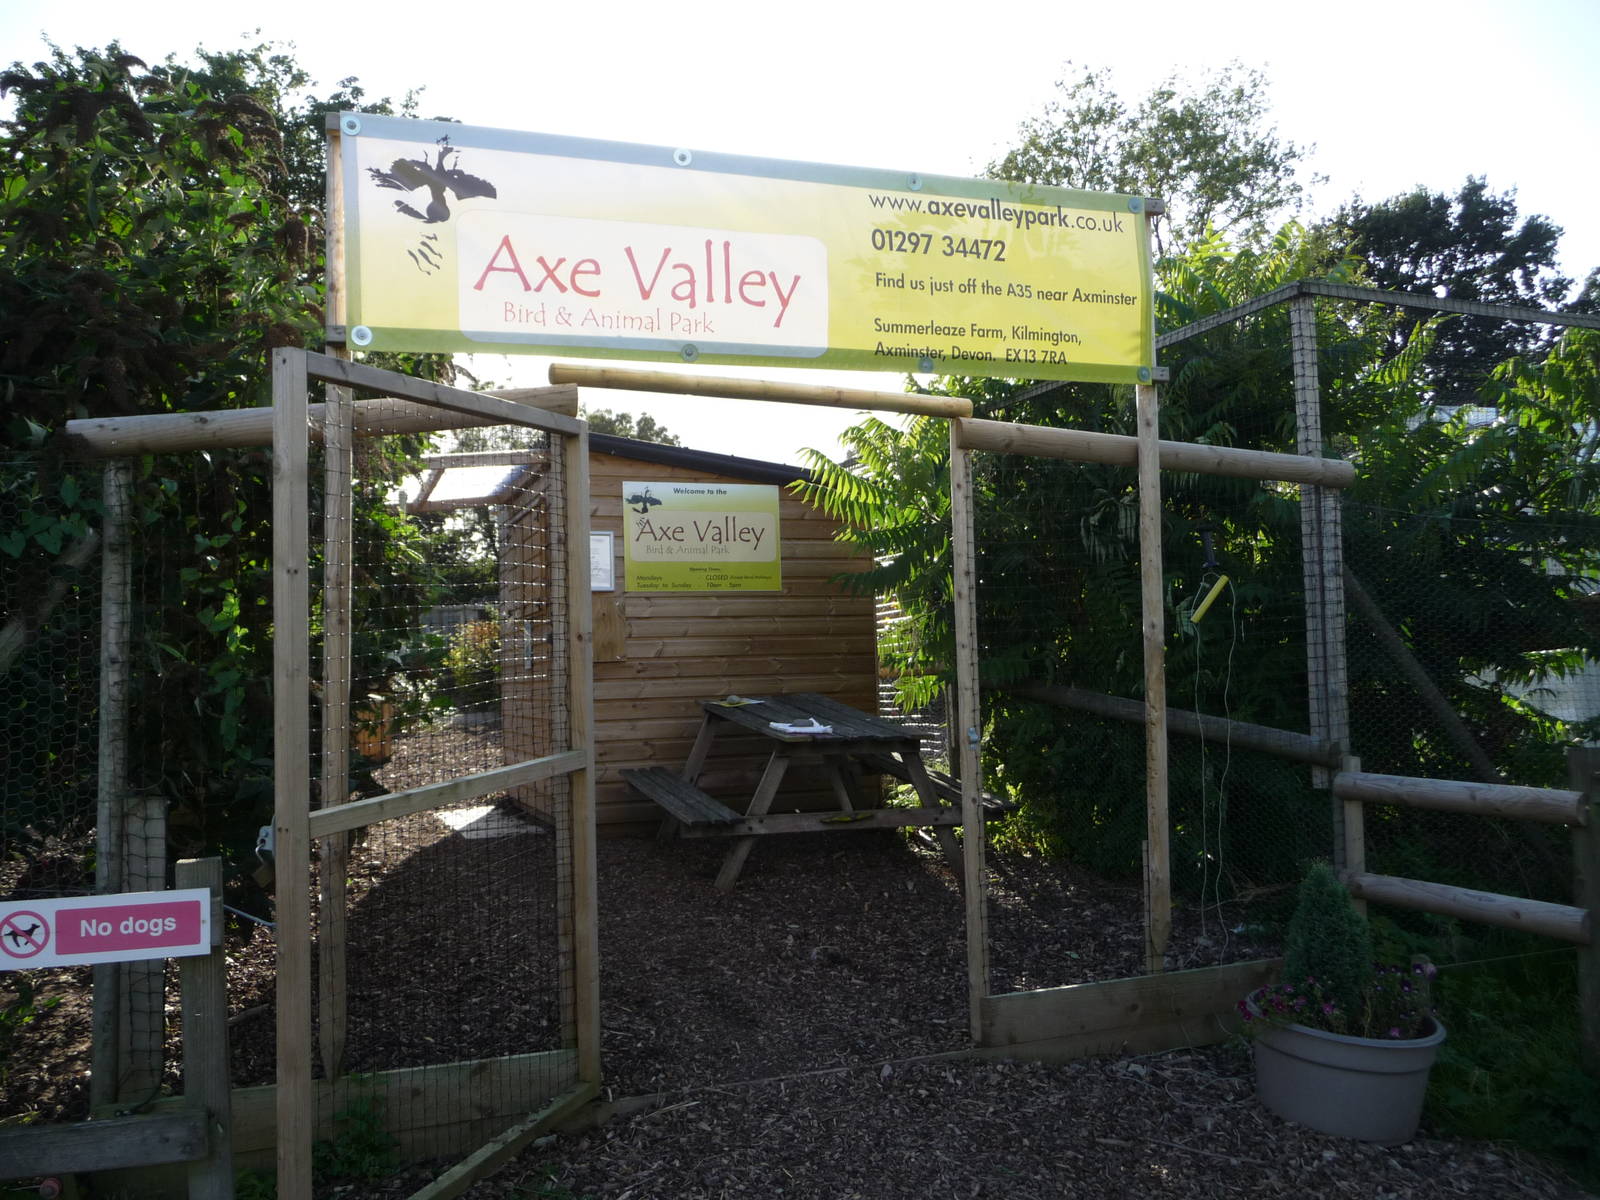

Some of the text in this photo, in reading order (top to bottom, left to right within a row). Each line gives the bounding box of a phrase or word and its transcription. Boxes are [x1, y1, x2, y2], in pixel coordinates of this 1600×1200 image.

[868, 194, 1124, 233] www.axevalleypark.co.uk
[871, 228, 1006, 262] 01297 34472
[473, 234, 801, 328] Axe Valley
[875, 272, 1138, 305] Find us just off the A35 near Axminster
[503, 301, 715, 335] Bird & Animal Park
[874, 318, 1082, 346] Summerleaze Farm, Kilmington,
[875, 342, 1067, 365] Axminster, Devon. EX13 7RA
[673, 487, 705, 495] Welcome
[635, 516, 765, 551] Axe Valley
[646, 544, 730, 556] Bird & Animal Park
[80, 916, 177, 937] No dogs
